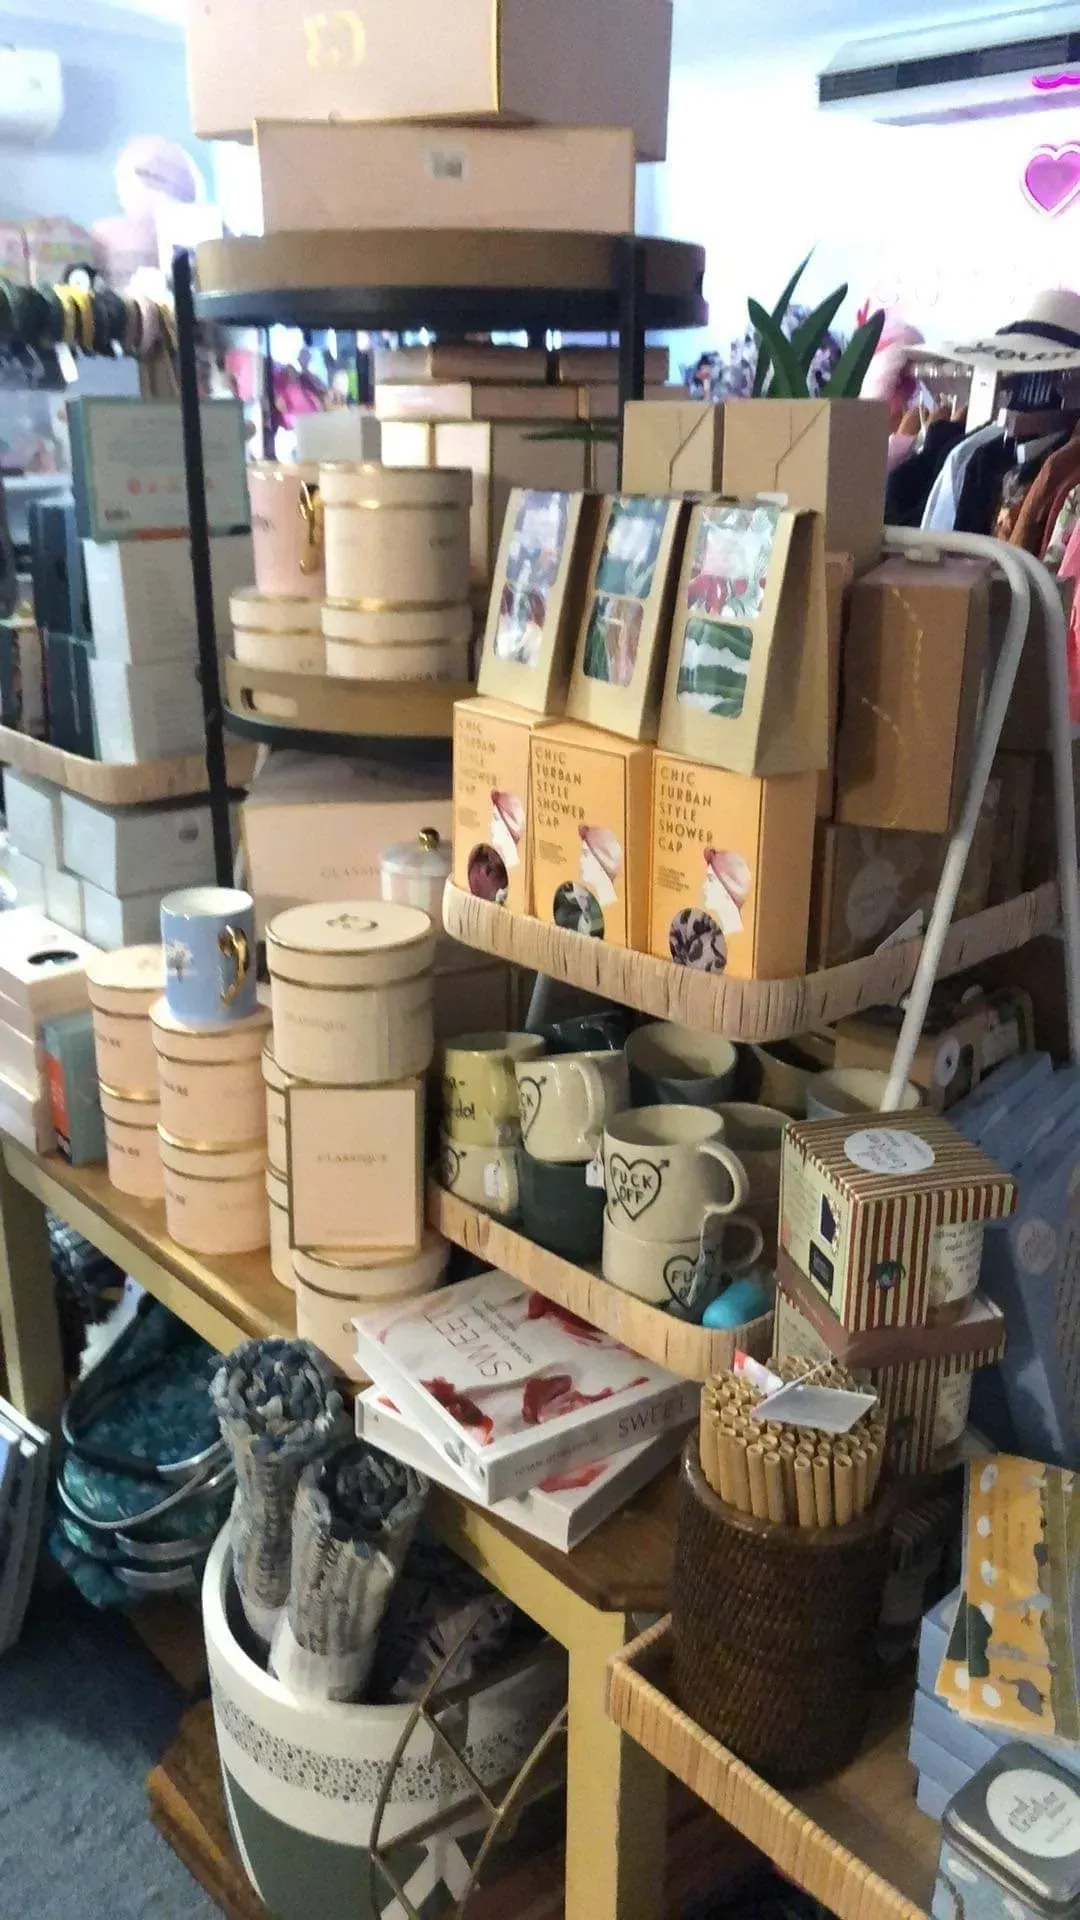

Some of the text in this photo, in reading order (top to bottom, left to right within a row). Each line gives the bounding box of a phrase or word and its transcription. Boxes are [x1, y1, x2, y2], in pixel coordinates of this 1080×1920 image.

[535, 747, 568, 766] CHIC
[536, 764, 582, 785] TURBAN
[660, 766, 696, 787] CHIC
[537, 780, 569, 800] STYLE
[660, 784, 712, 808] TURBAN
[537, 796, 586, 821] SHOWER
[659, 801, 697, 823] STYLE
[537, 812, 561, 831] CAP
[659, 818, 714, 843] SHOWER
[658, 836, 683, 853] CAP
[613, 1165, 652, 1189] FUCK
[619, 1185, 646, 1205] OFF
[423, 1306, 513, 1378] SWEET
[618, 1394, 689, 1440] SWEET
